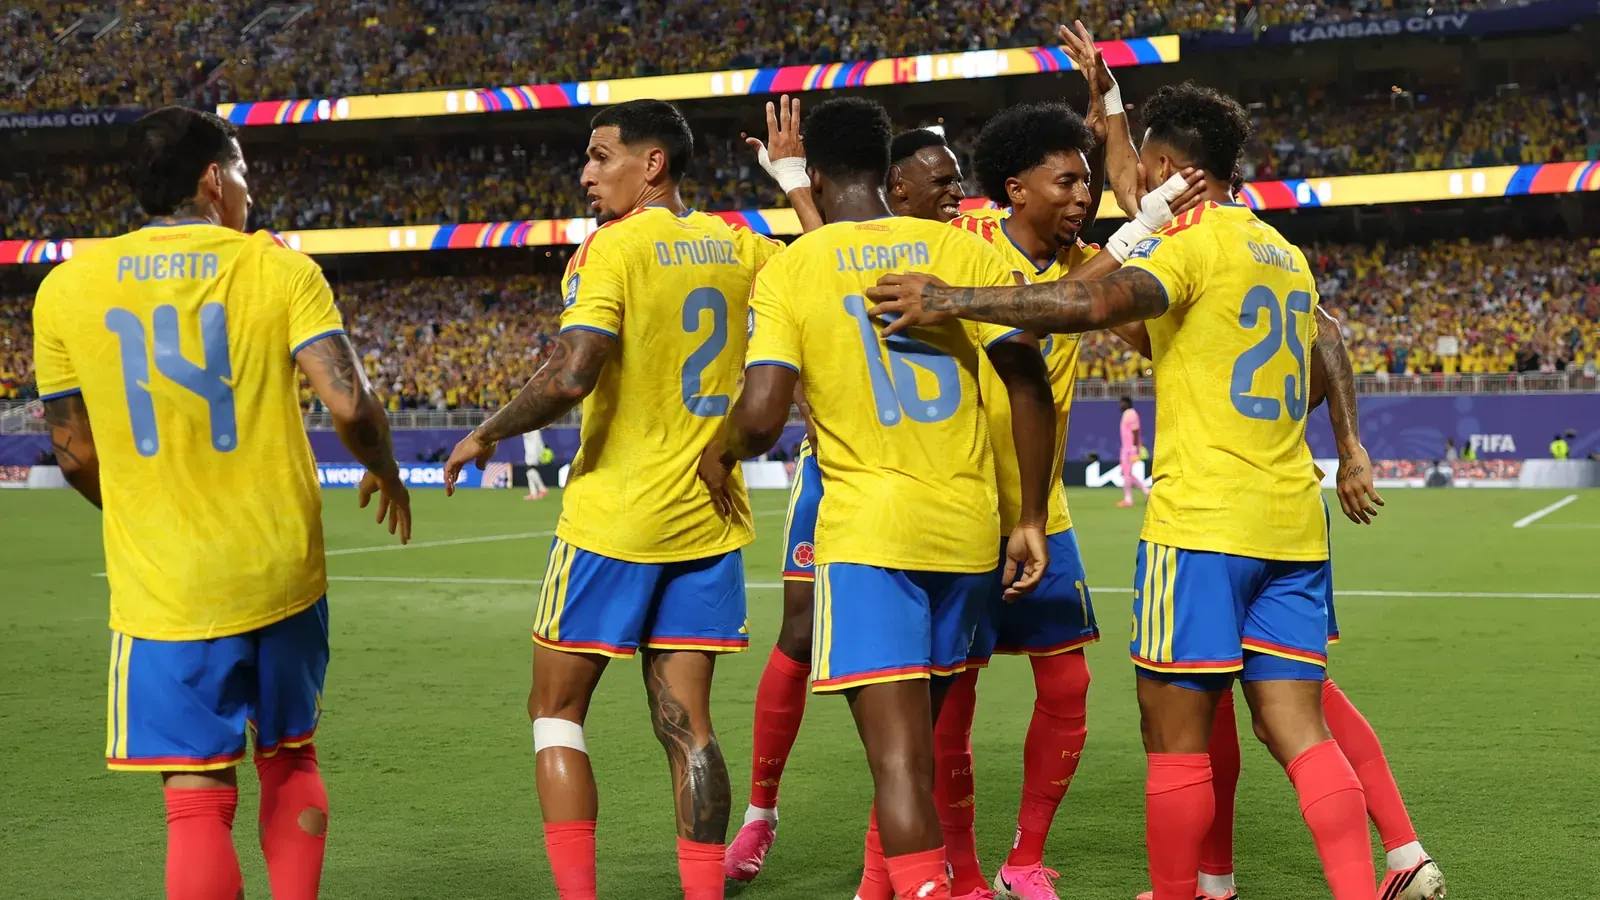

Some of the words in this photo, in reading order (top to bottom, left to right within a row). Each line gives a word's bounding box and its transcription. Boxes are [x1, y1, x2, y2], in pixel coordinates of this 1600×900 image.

[1290, 19, 1401, 42] KANSAS
[0, 114, 67, 128] ANSAS
[655, 235, 739, 267] D.MUÑOZ
[836, 241, 930, 272] J.LERMA
[117, 252, 218, 283] PUERTA
[681, 286, 730, 418] 2
[843, 294, 961, 427] 16
[1230, 285, 1311, 422] 25
[105, 302, 237, 457] 14
[1469, 433, 1517, 453] FIFA
[325, 467, 366, 484] WOR
[410, 467, 461, 484] 202
[760, 756, 781, 766] FCF
[1061, 750, 1081, 759] FC
